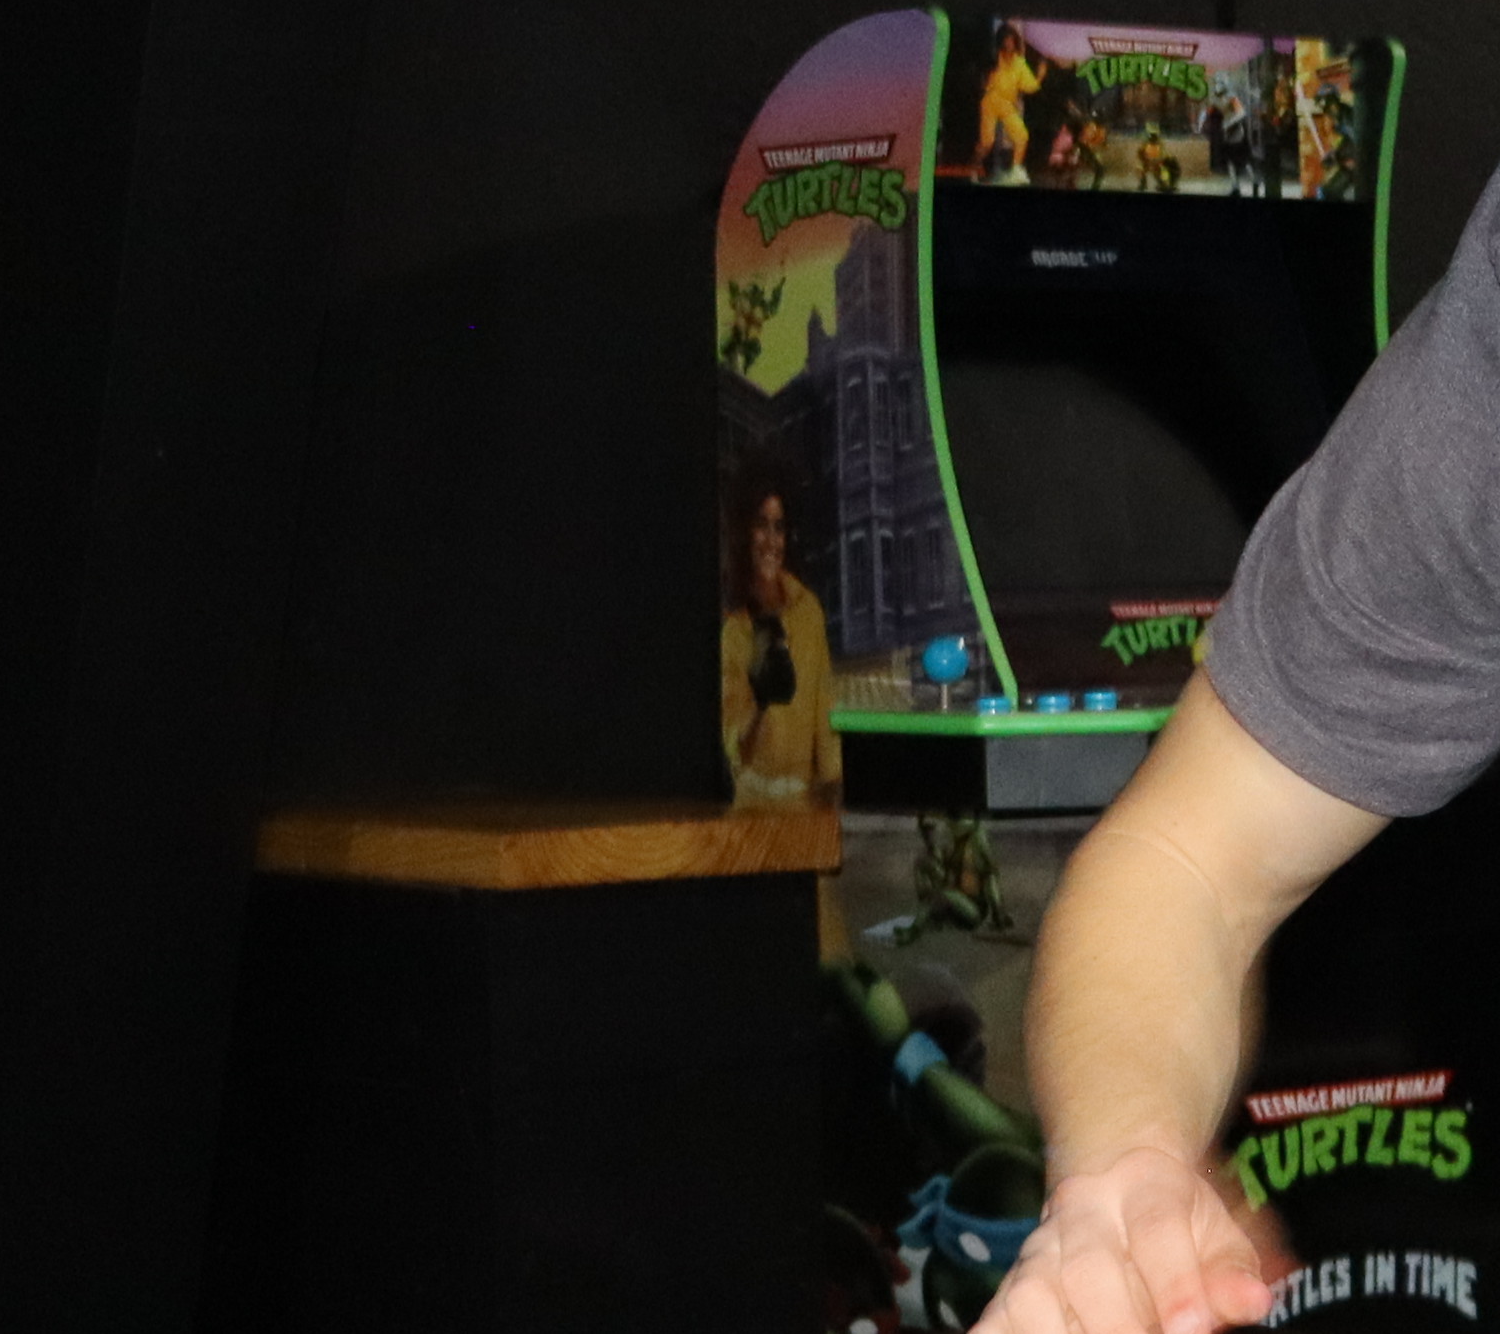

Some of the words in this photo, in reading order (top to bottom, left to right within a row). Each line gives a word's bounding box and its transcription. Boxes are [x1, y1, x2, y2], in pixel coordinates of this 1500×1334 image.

[1075, 52, 1209, 101] TURTLES
[743, 160, 908, 248] TURTLES
[1249, 1088, 1330, 1120] TEENAGE
[1330, 1080, 1395, 1110] MUTANT
[1395, 1073, 1447, 1101] NINJA
[1231, 1104, 1474, 1214] TURTLES
[1264, 1253, 1352, 1330] RTLES
[1363, 1248, 1397, 1297] IN
[1404, 1246, 1479, 1322] TIME
